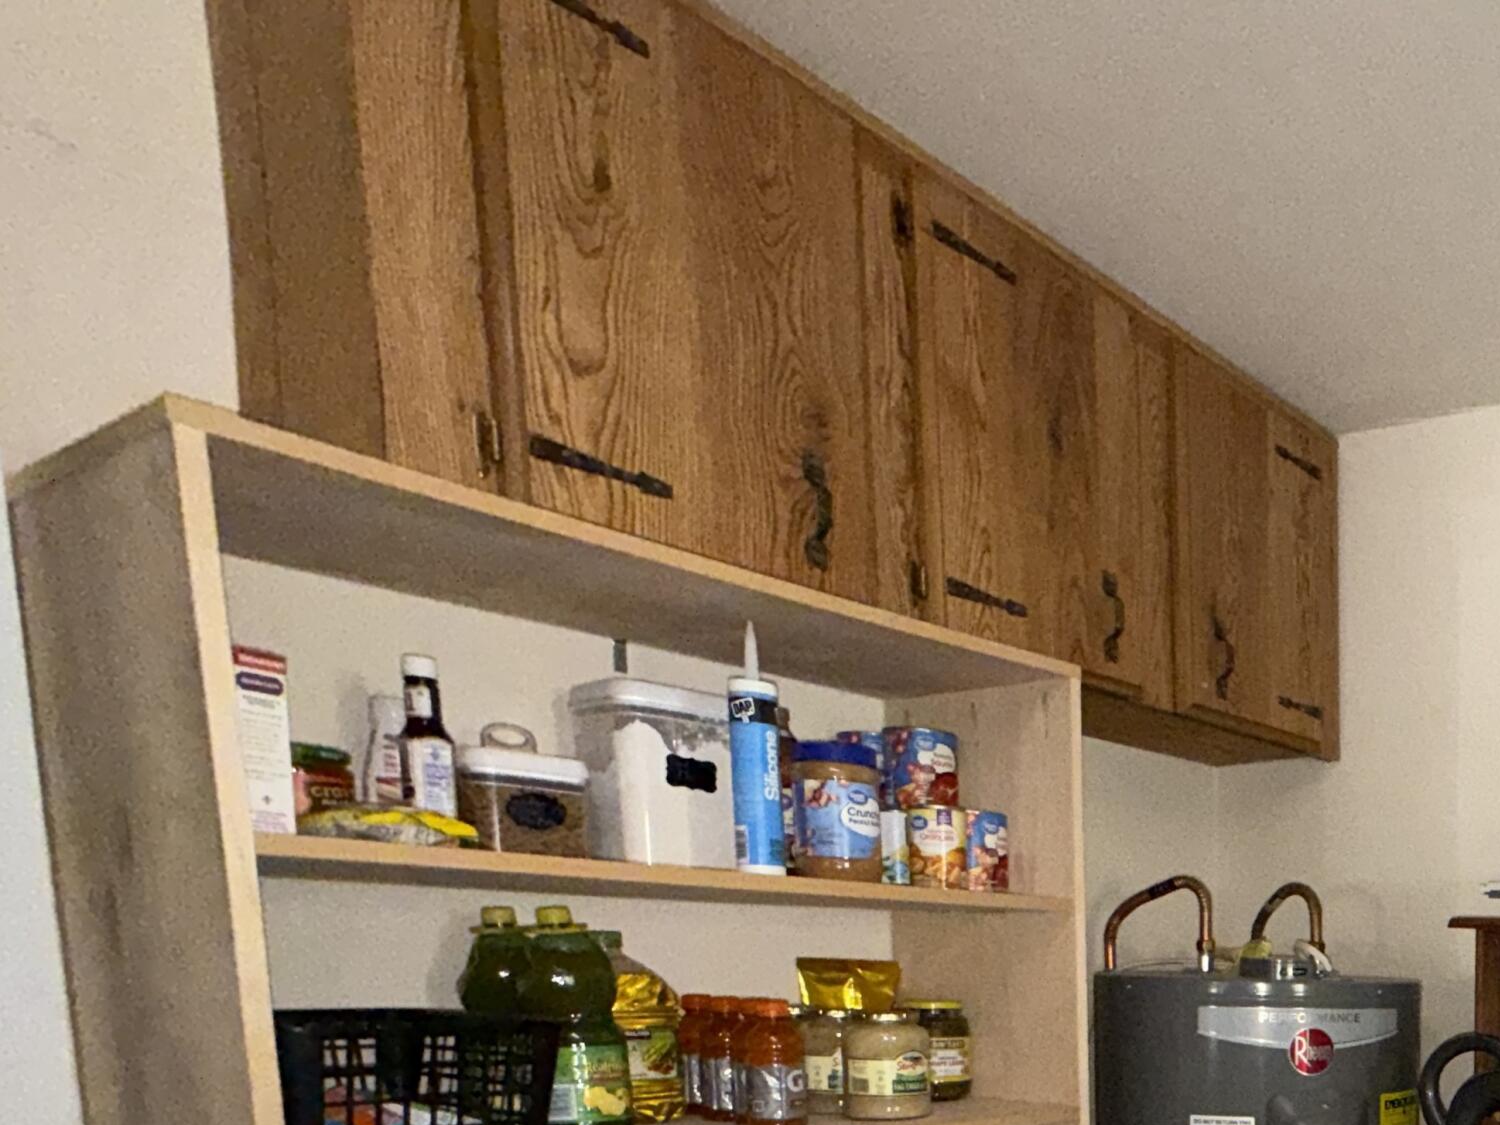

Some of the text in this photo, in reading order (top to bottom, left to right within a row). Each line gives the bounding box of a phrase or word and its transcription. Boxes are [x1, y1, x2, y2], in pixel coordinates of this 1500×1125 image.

[732, 700, 753, 715] DAP
[764, 730, 780, 801] Silicone
[1258, 1011, 1361, 1023] PEFOMANCE
